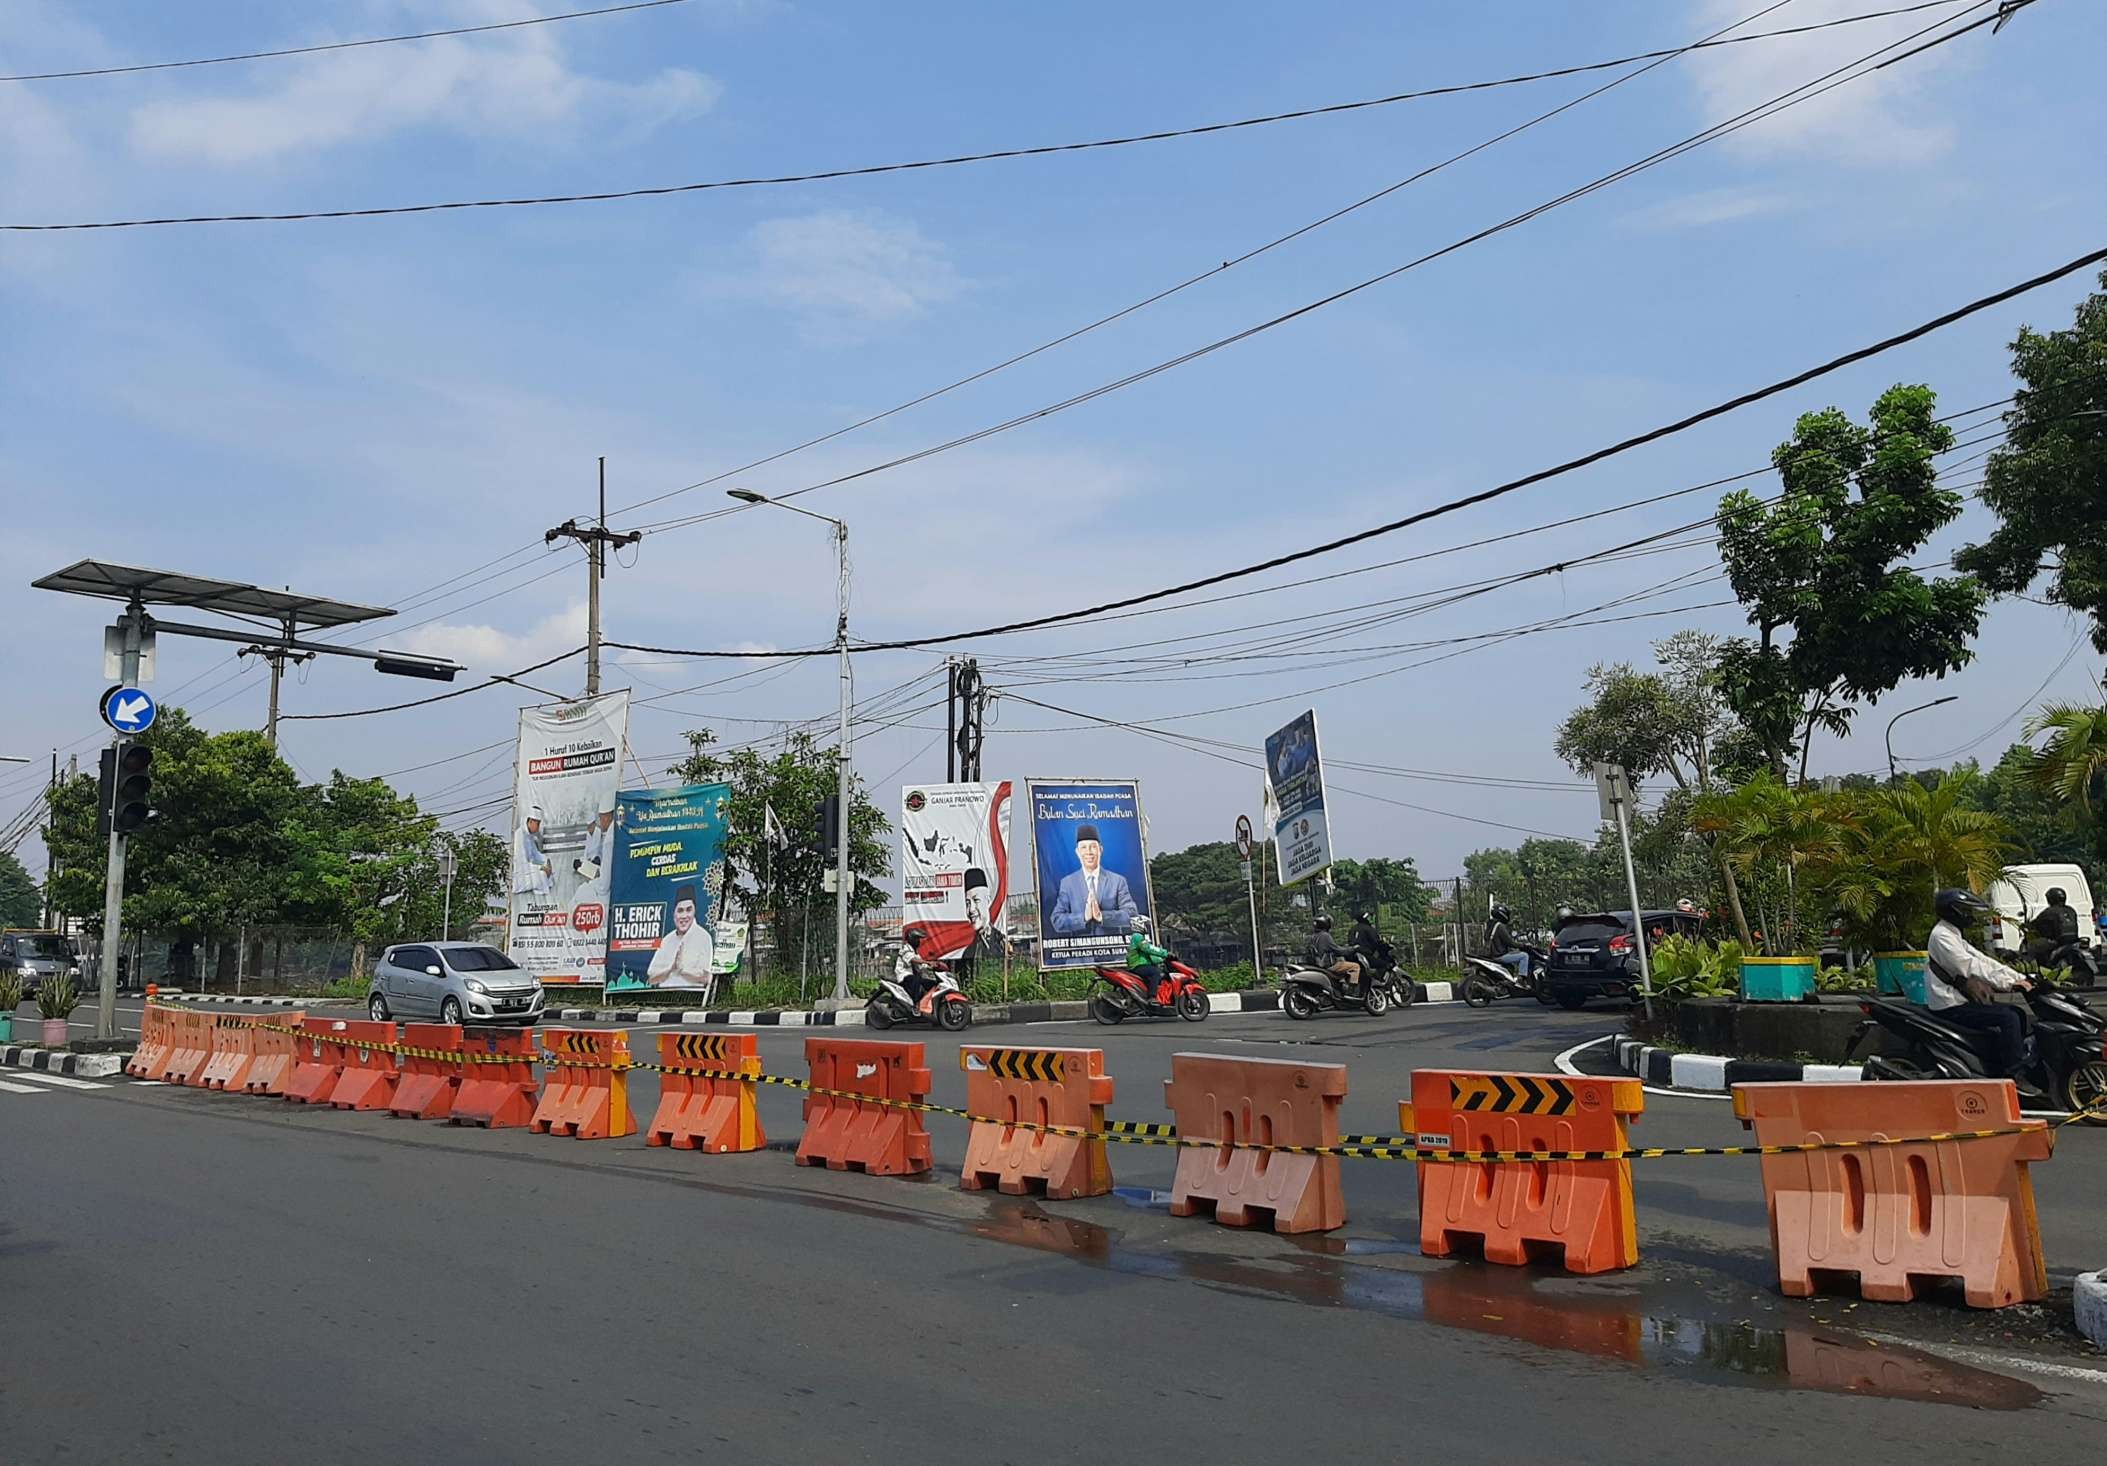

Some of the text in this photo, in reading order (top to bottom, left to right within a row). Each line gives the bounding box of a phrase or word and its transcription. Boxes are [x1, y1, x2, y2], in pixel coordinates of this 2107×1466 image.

[549, 746, 567, 756] Huruf
[568, 744, 575, 753] 10
[577, 740, 603, 751] Kebaikan
[530, 751, 615, 772] BANGUN RUMAH QUR'AN
[931, 795, 985, 804] GANJAR PRANOWO
[1039, 803, 1133, 820] Bulan Suci Ramadhan
[527, 902, 558, 914] Tabungan
[614, 905, 663, 923] H. ERICK
[519, 915, 543, 925] Rumah
[575, 911, 601, 925] 250rb
[614, 922, 661, 939] THOHIR
[1043, 938, 1069, 949] ROBERT
[1052, 950, 1070, 958] KETUA
[1071, 949, 1092, 957] PERADI
[1094, 948, 1110, 956] KOTA
